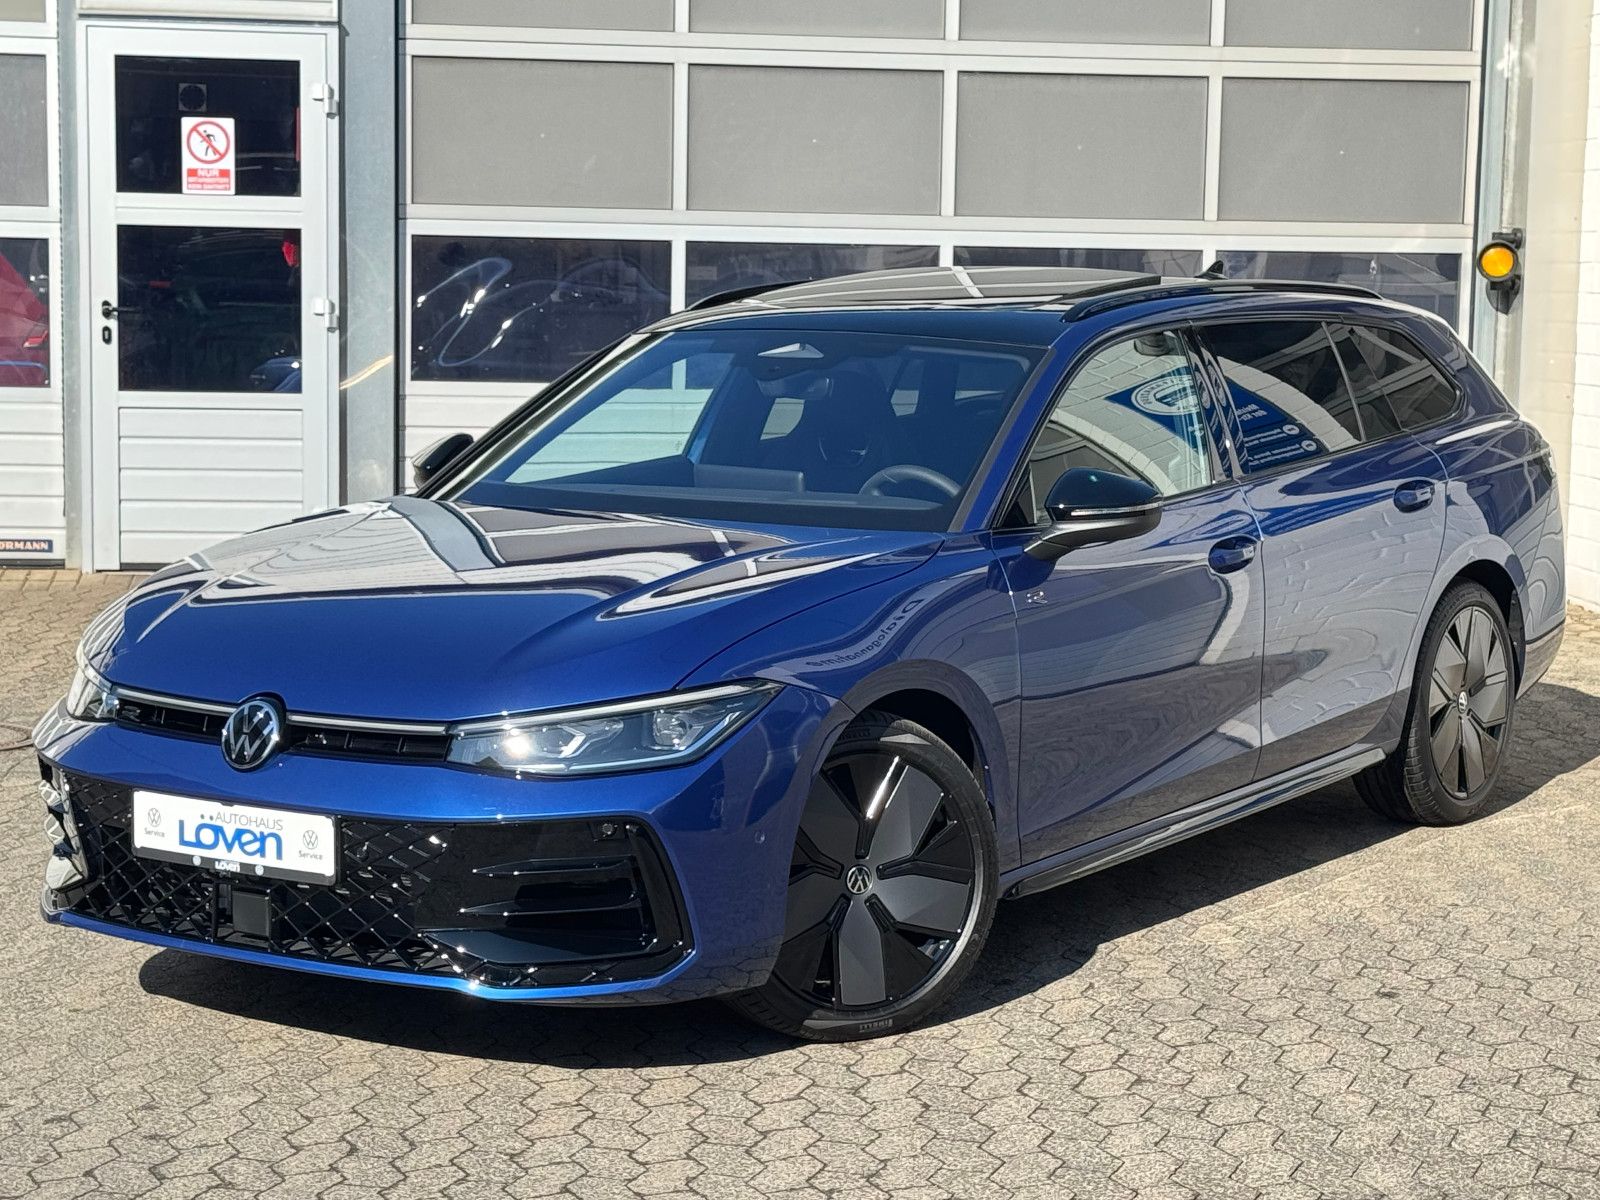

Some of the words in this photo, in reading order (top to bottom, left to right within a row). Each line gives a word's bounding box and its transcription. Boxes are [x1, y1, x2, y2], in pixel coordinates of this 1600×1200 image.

[197, 168, 219, 178] NUR
[214, 811, 284, 831] AUTOHAUS
[143, 827, 165, 838] Service
[178, 813, 283, 860] Löven
[298, 850, 323, 861] Service
